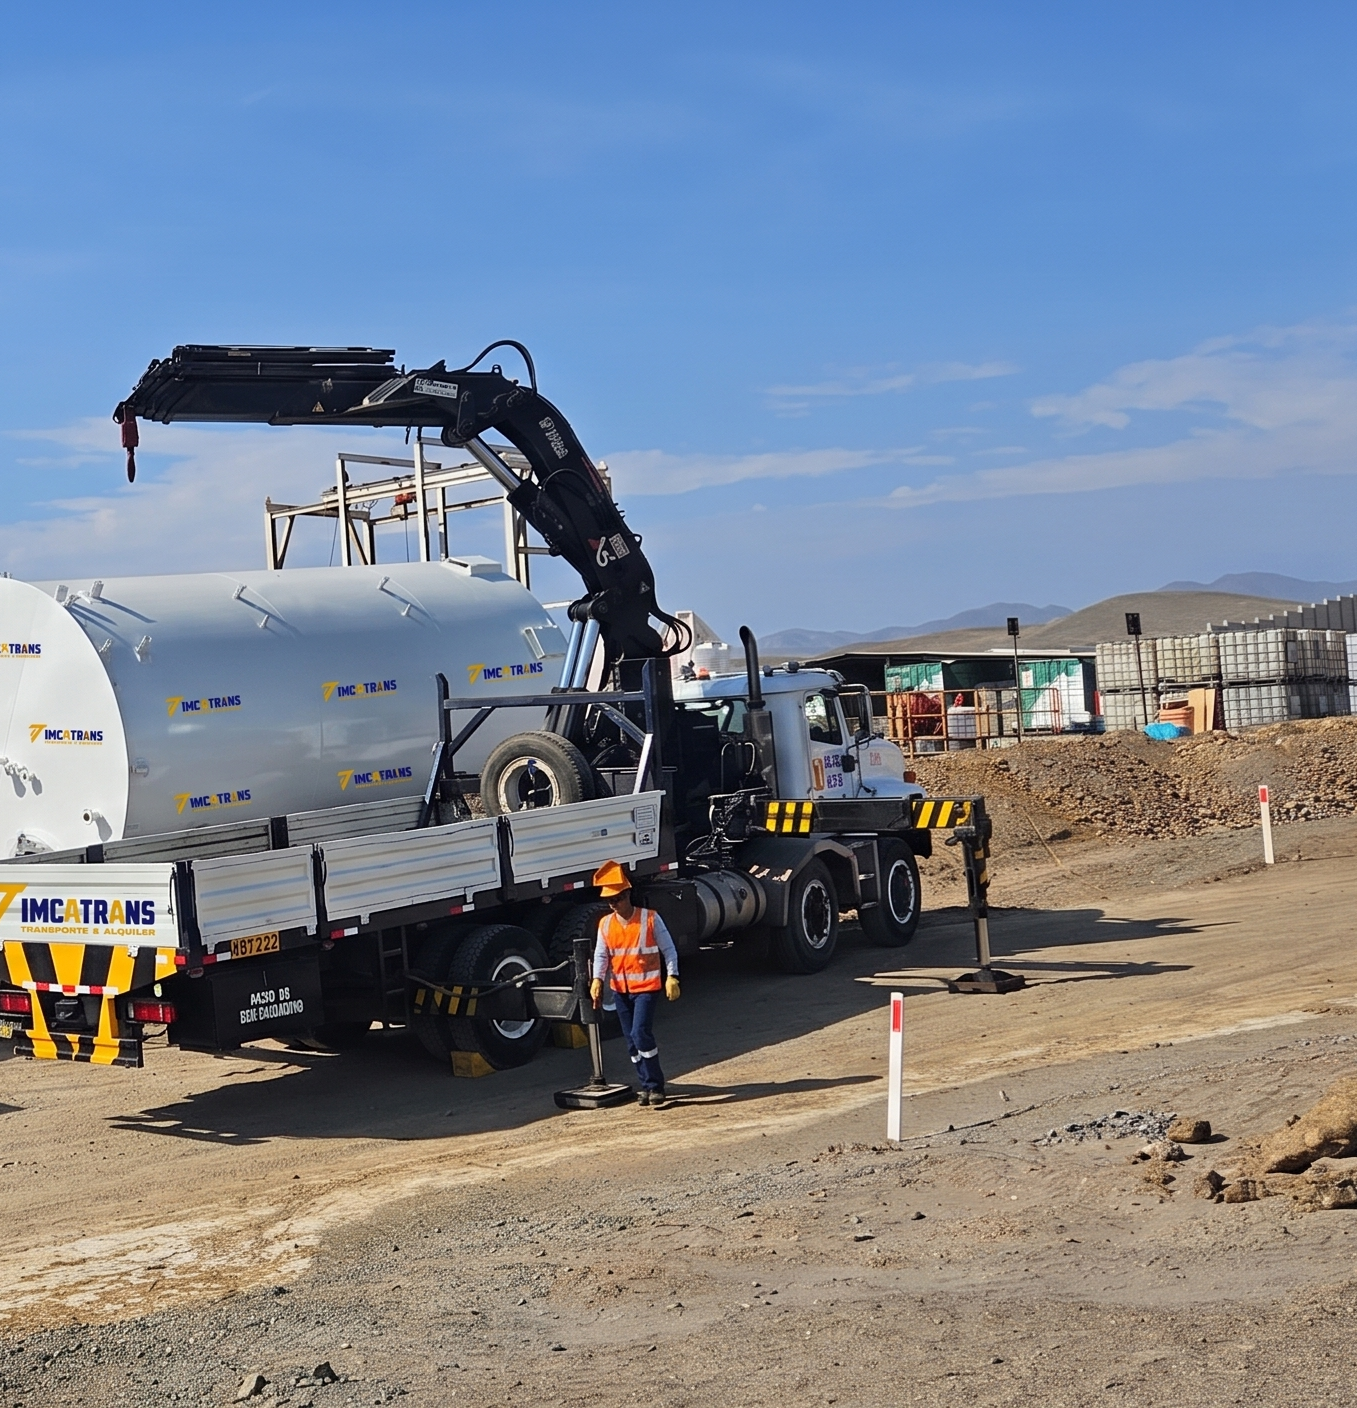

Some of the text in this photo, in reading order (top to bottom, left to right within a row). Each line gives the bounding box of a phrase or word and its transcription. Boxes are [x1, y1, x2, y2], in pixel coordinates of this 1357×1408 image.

[44, 729, 103, 741] IMCATRANS
[21, 898, 155, 925] IMCATRANS
[103, 927, 156, 936] ALQUILER
